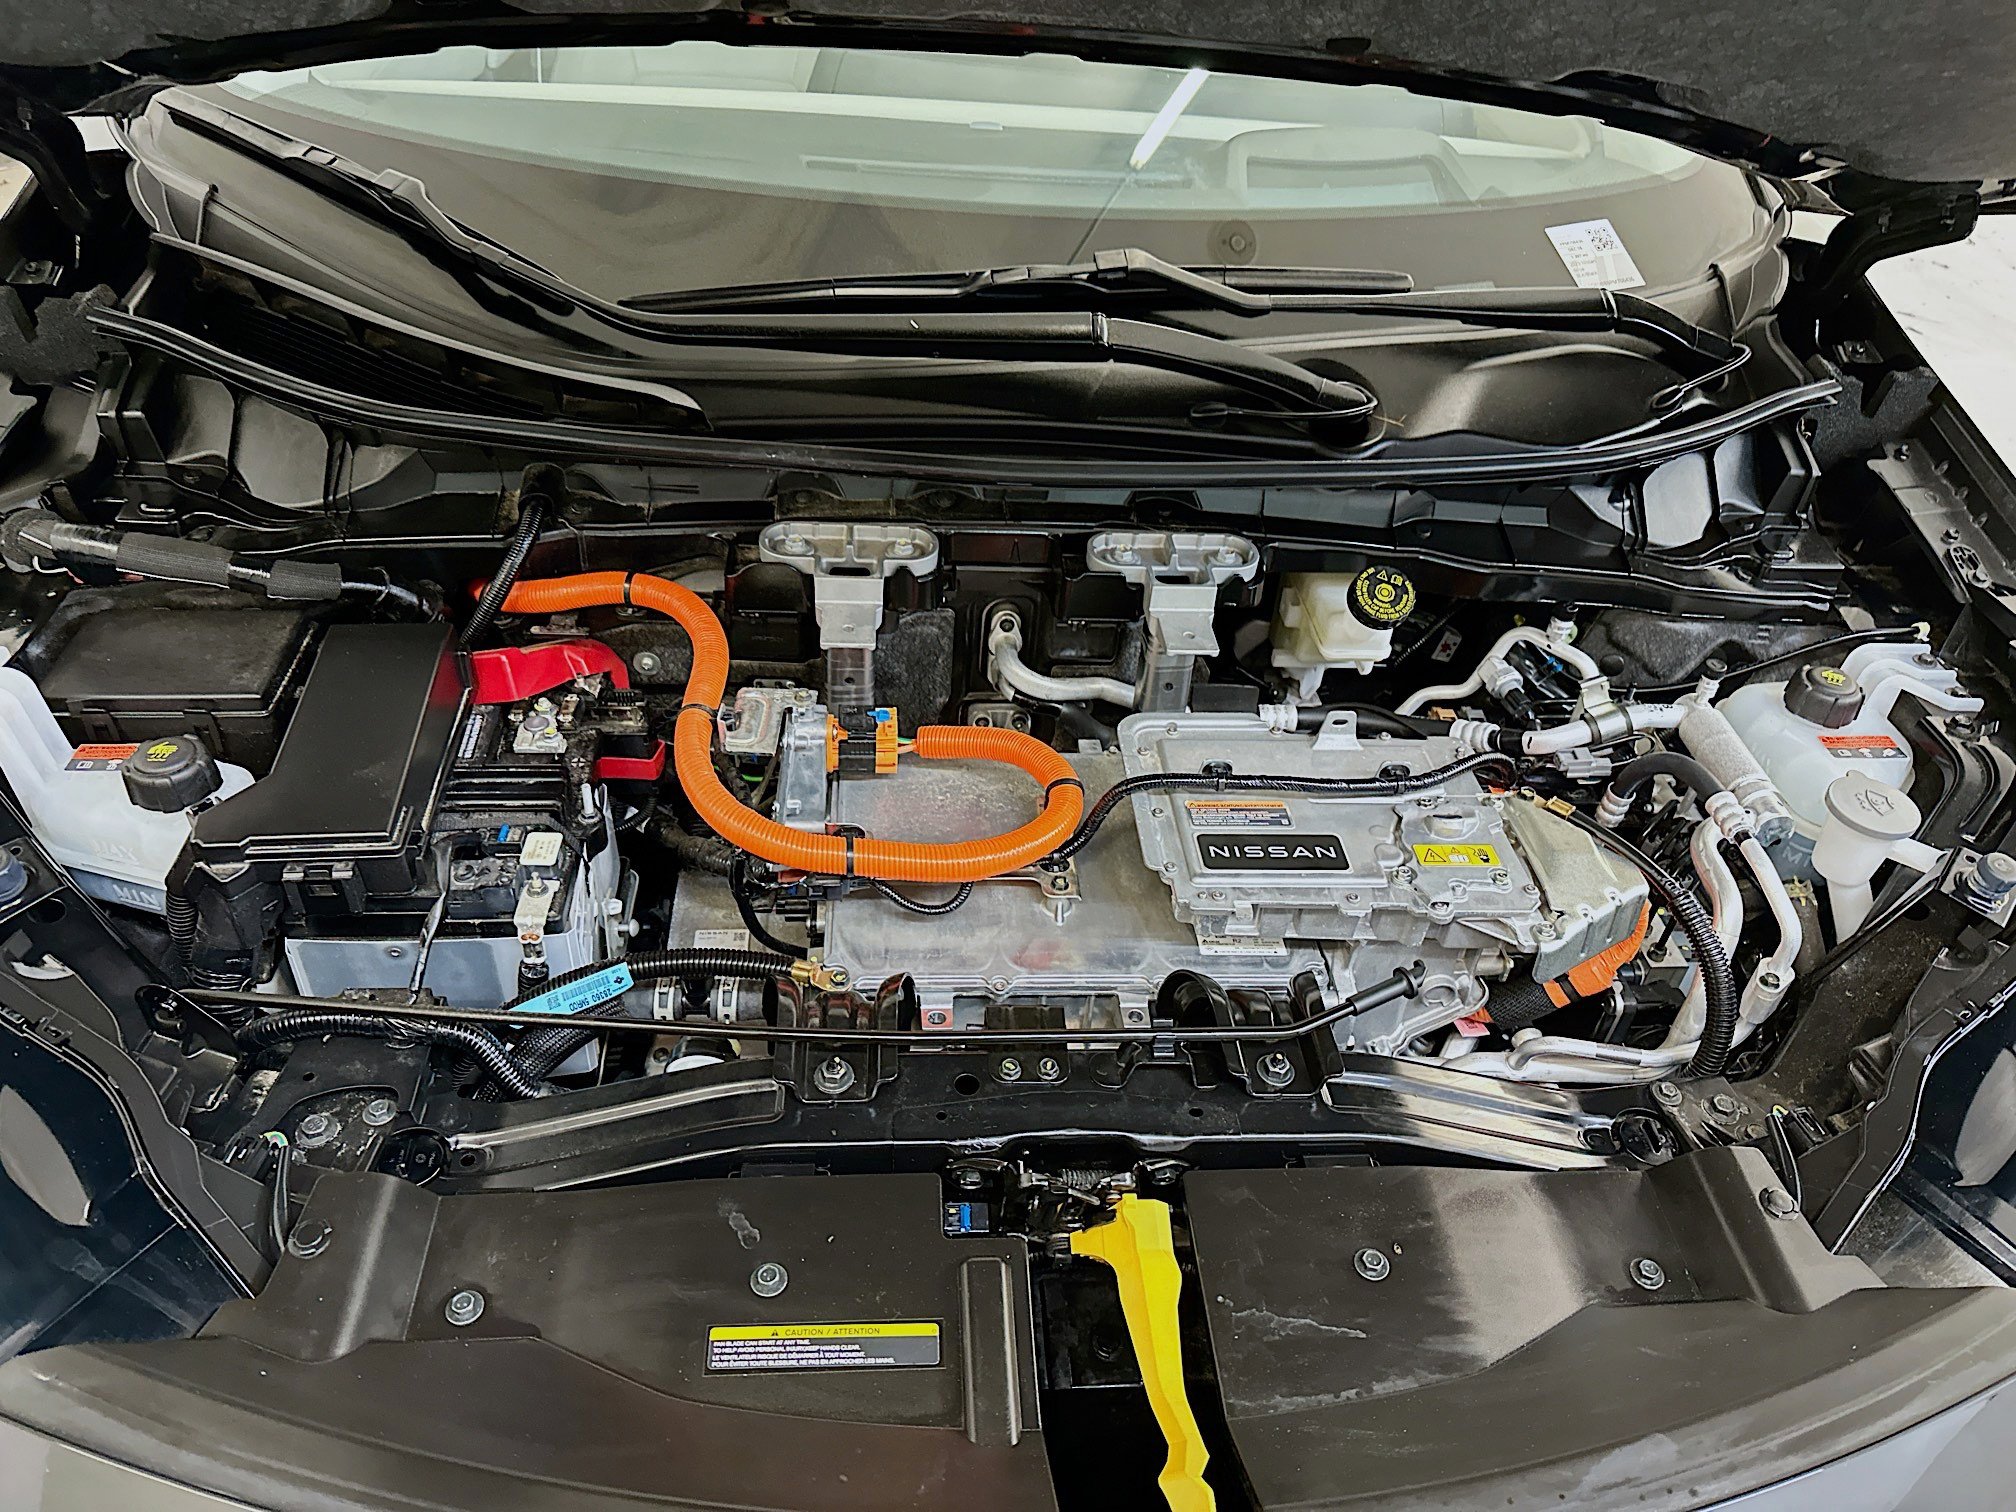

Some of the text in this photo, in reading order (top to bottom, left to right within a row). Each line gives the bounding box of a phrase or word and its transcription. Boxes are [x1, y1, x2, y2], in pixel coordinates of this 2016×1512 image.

[1208, 845, 1337, 858] NISSAN
[1782, 845, 1812, 868] MI
[112, 884, 160, 907] MIN
[784, 1328, 824, 1336] CAUTION
[833, 1327, 881, 1335] ATTENTION
[788, 1351, 820, 1359] DÉMARRER
[729, 1359, 749, 1367] ÉVITER
